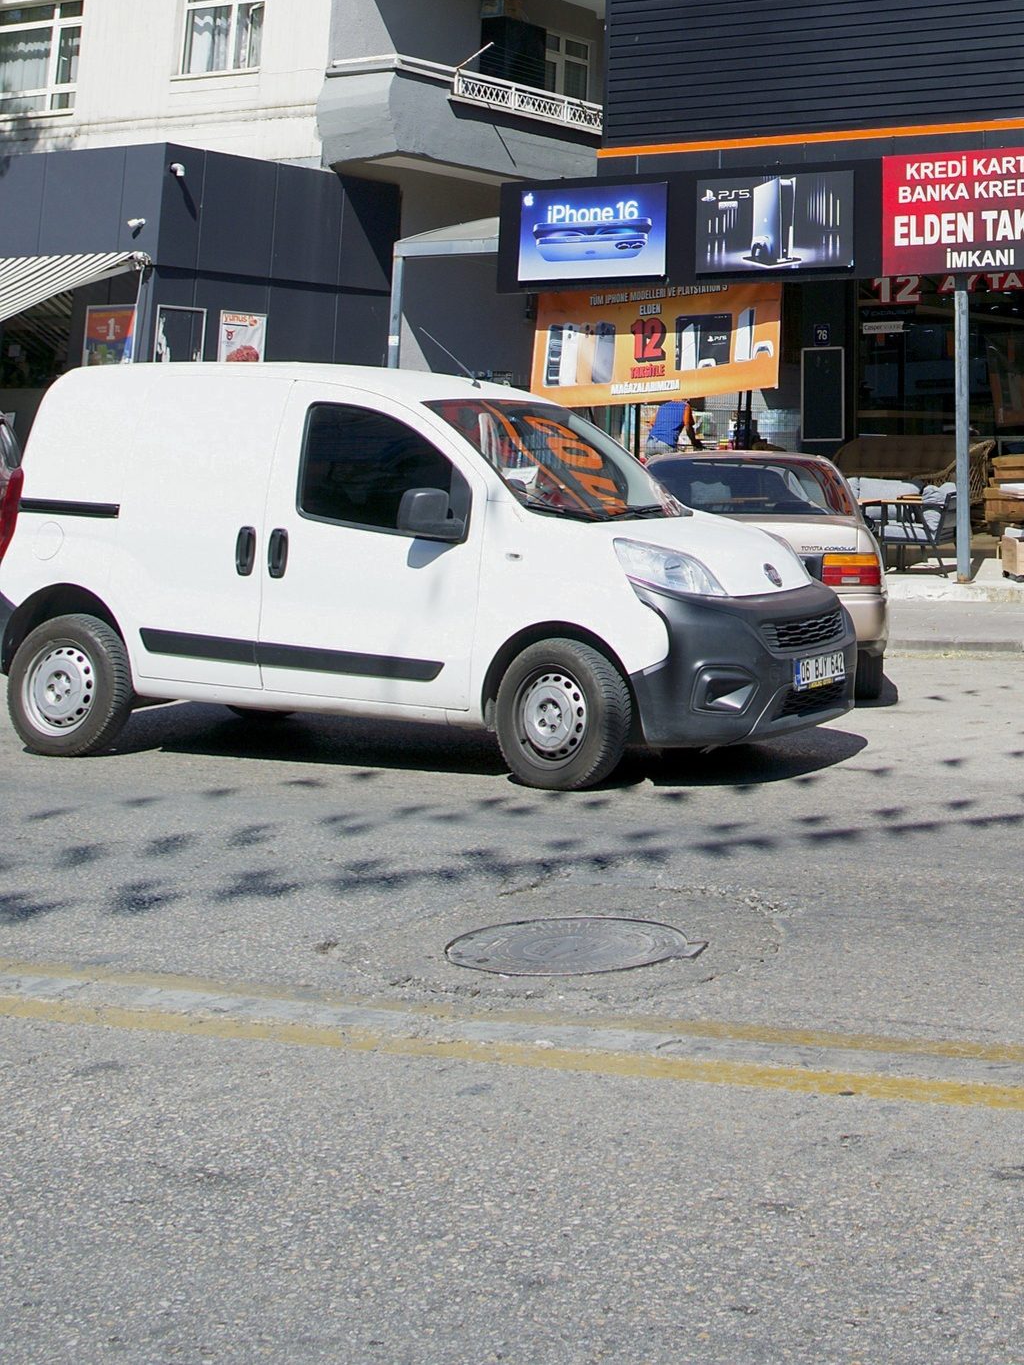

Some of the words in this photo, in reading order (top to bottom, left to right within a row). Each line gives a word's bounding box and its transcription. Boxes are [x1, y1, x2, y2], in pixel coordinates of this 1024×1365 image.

[906, 156, 967, 180] KREDİ
[718, 189, 750, 200] PS5
[899, 183, 970, 204] BANKA
[547, 205, 613, 224] iPhone
[616, 200, 639, 219] 16
[894, 211, 974, 247] ELDEN
[946, 248, 1015, 269] İMKANI
[873, 275, 920, 303] 12
[224, 314, 248, 323] yunus
[640, 304, 661, 315] ELDEN
[106, 318, 115, 340] 1
[631, 317, 666, 362] 12
[816, 329, 827, 340] 76
[801, 661, 810, 682] 06
[831, 653, 843, 674] 642
